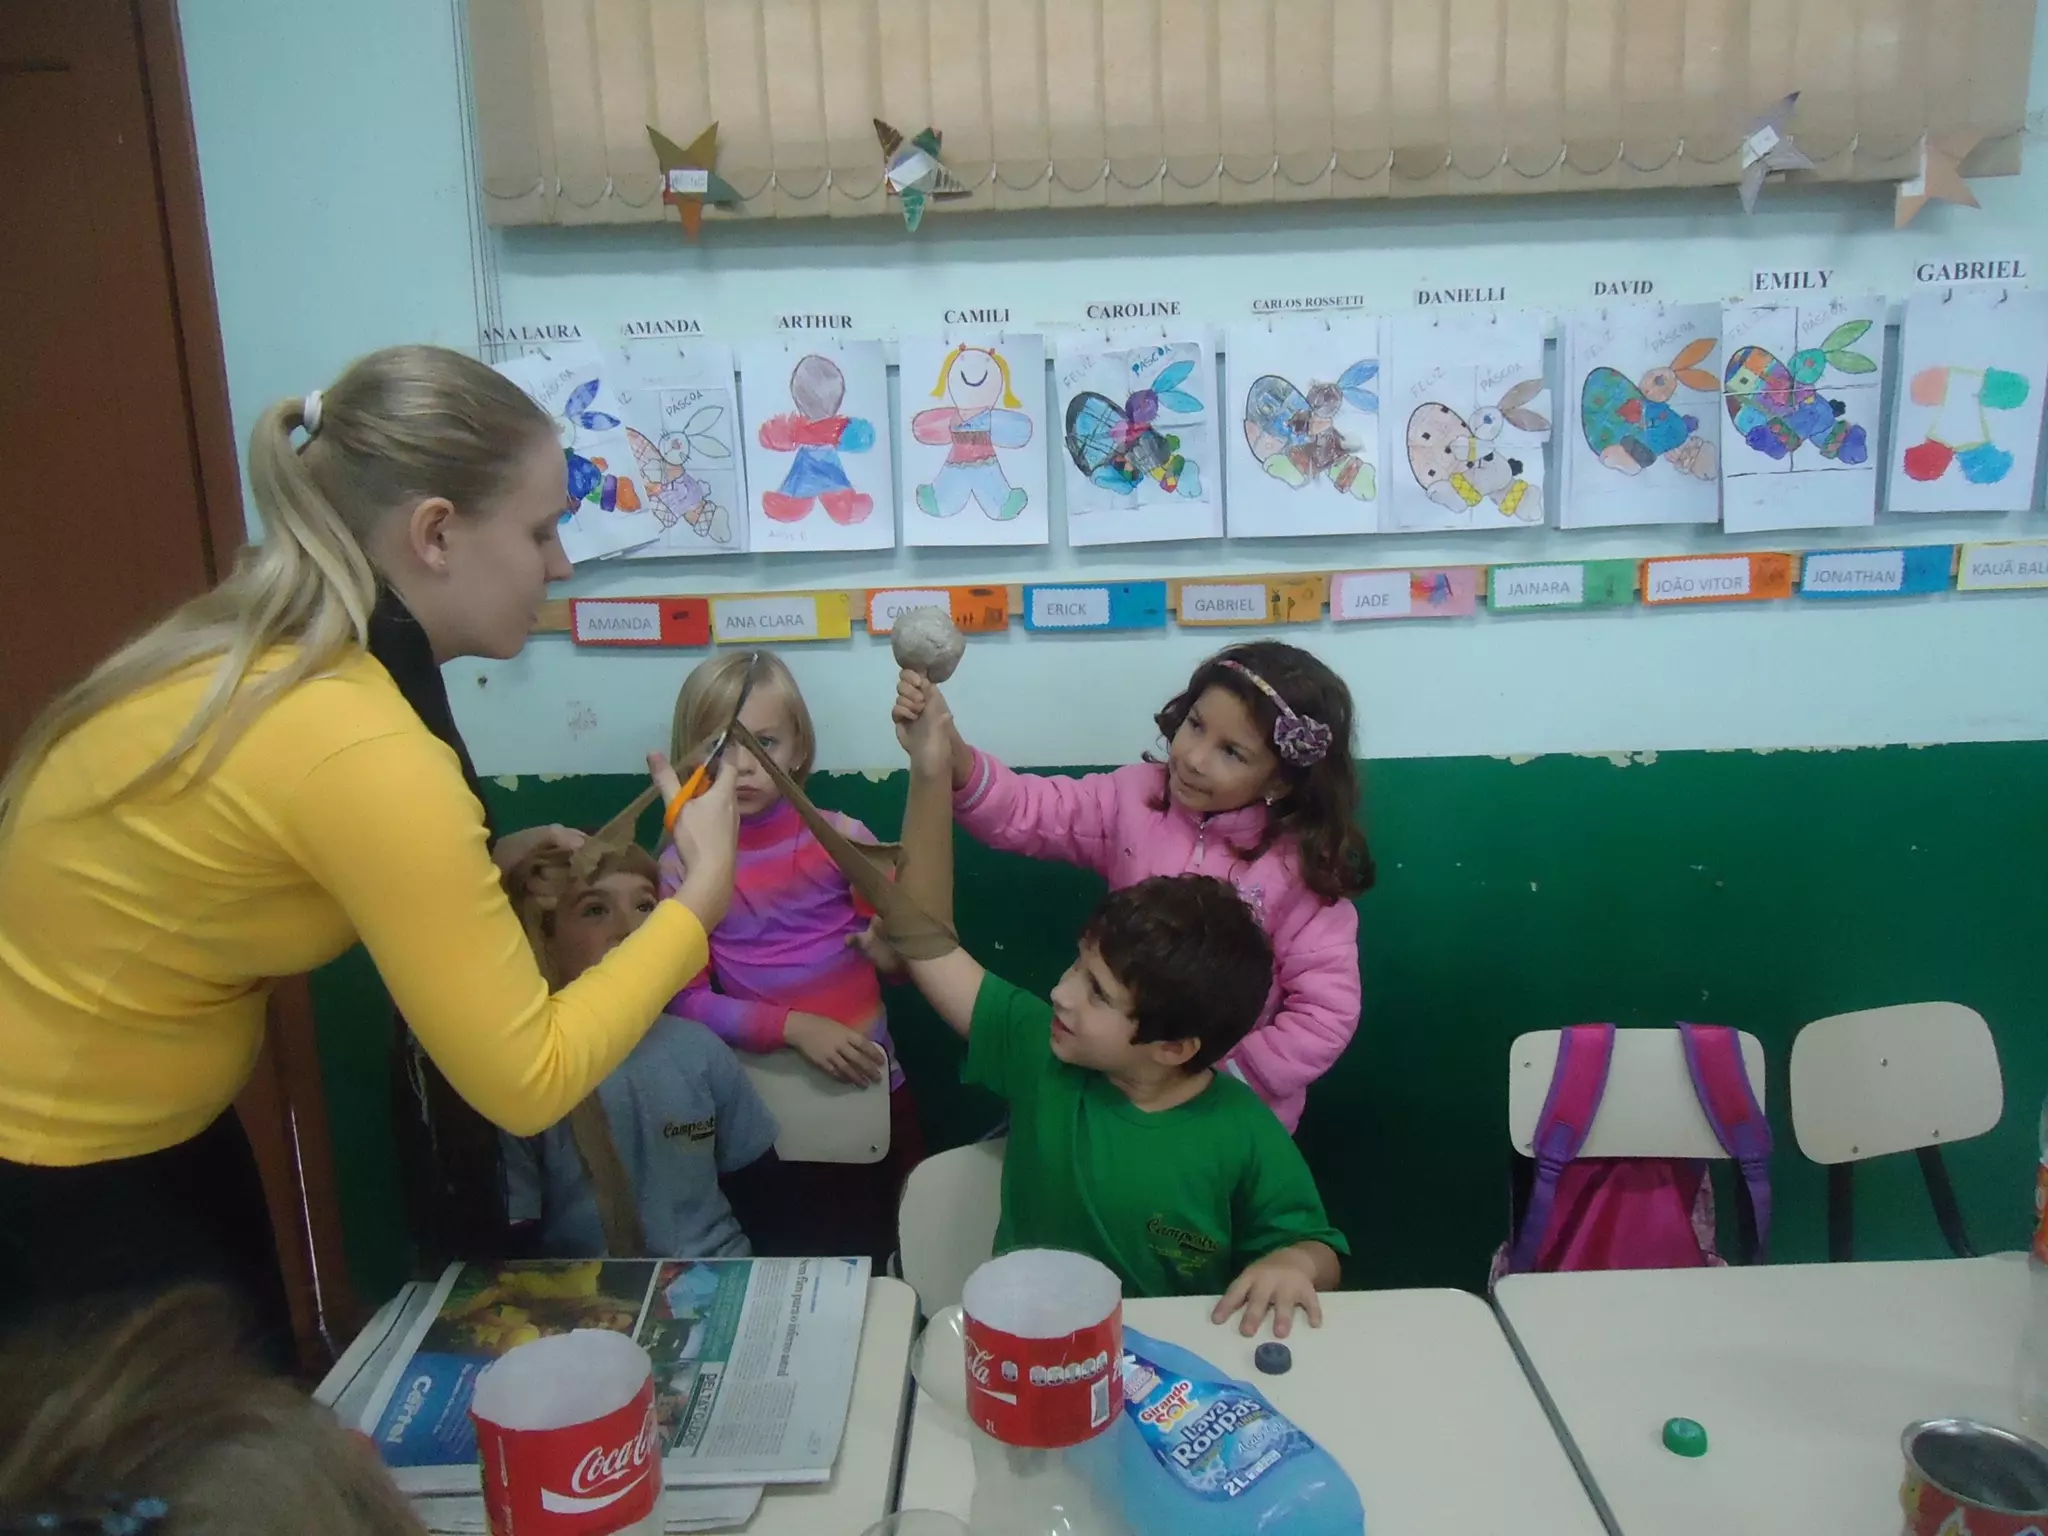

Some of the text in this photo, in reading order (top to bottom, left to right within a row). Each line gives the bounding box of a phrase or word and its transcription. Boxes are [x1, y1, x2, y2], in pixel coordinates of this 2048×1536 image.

[1916, 259, 2027, 282] GABRIEL
[1594, 280, 1653, 296] DAVID
[1755, 270, 1833, 290] EMILY
[1252, 295, 1364, 310] CARLOS ROSSETTI
[1418, 287, 1505, 305] DANIELLI
[943, 308, 1011, 325] CAMILI
[1086, 301, 1181, 319] CAROLINE
[623, 318, 702, 336] AMANDA
[777, 314, 853, 330] ARTHUR
[481, 324, 582, 343] ANA LAURA
[1062, 356, 1097, 389] FELIZ
[1410, 366, 1446, 399] FELIZ
[1811, 568, 1896, 584] JONATHAN
[2017, 561, 2048, 575] BAL
[1507, 581, 1570, 597] JAINARA
[1654, 573, 1744, 593] JOÃO VITOR
[1194, 598, 1256, 613] GABRIEL
[1355, 593, 1390, 608] JADE
[1046, 603, 1087, 617] ERICK
[587, 615, 653, 632] AMANDA
[725, 613, 805, 629] ANA CLARA
[663, 1116, 716, 1138] Campest
[1140, 1380, 1190, 1423] Girando
[985, 1418, 997, 1434] 2L
[1181, 1400, 1230, 1443] Lava
[1173, 1400, 1261, 1467] Roupas
[1223, 1473, 1250, 1497] 2L
